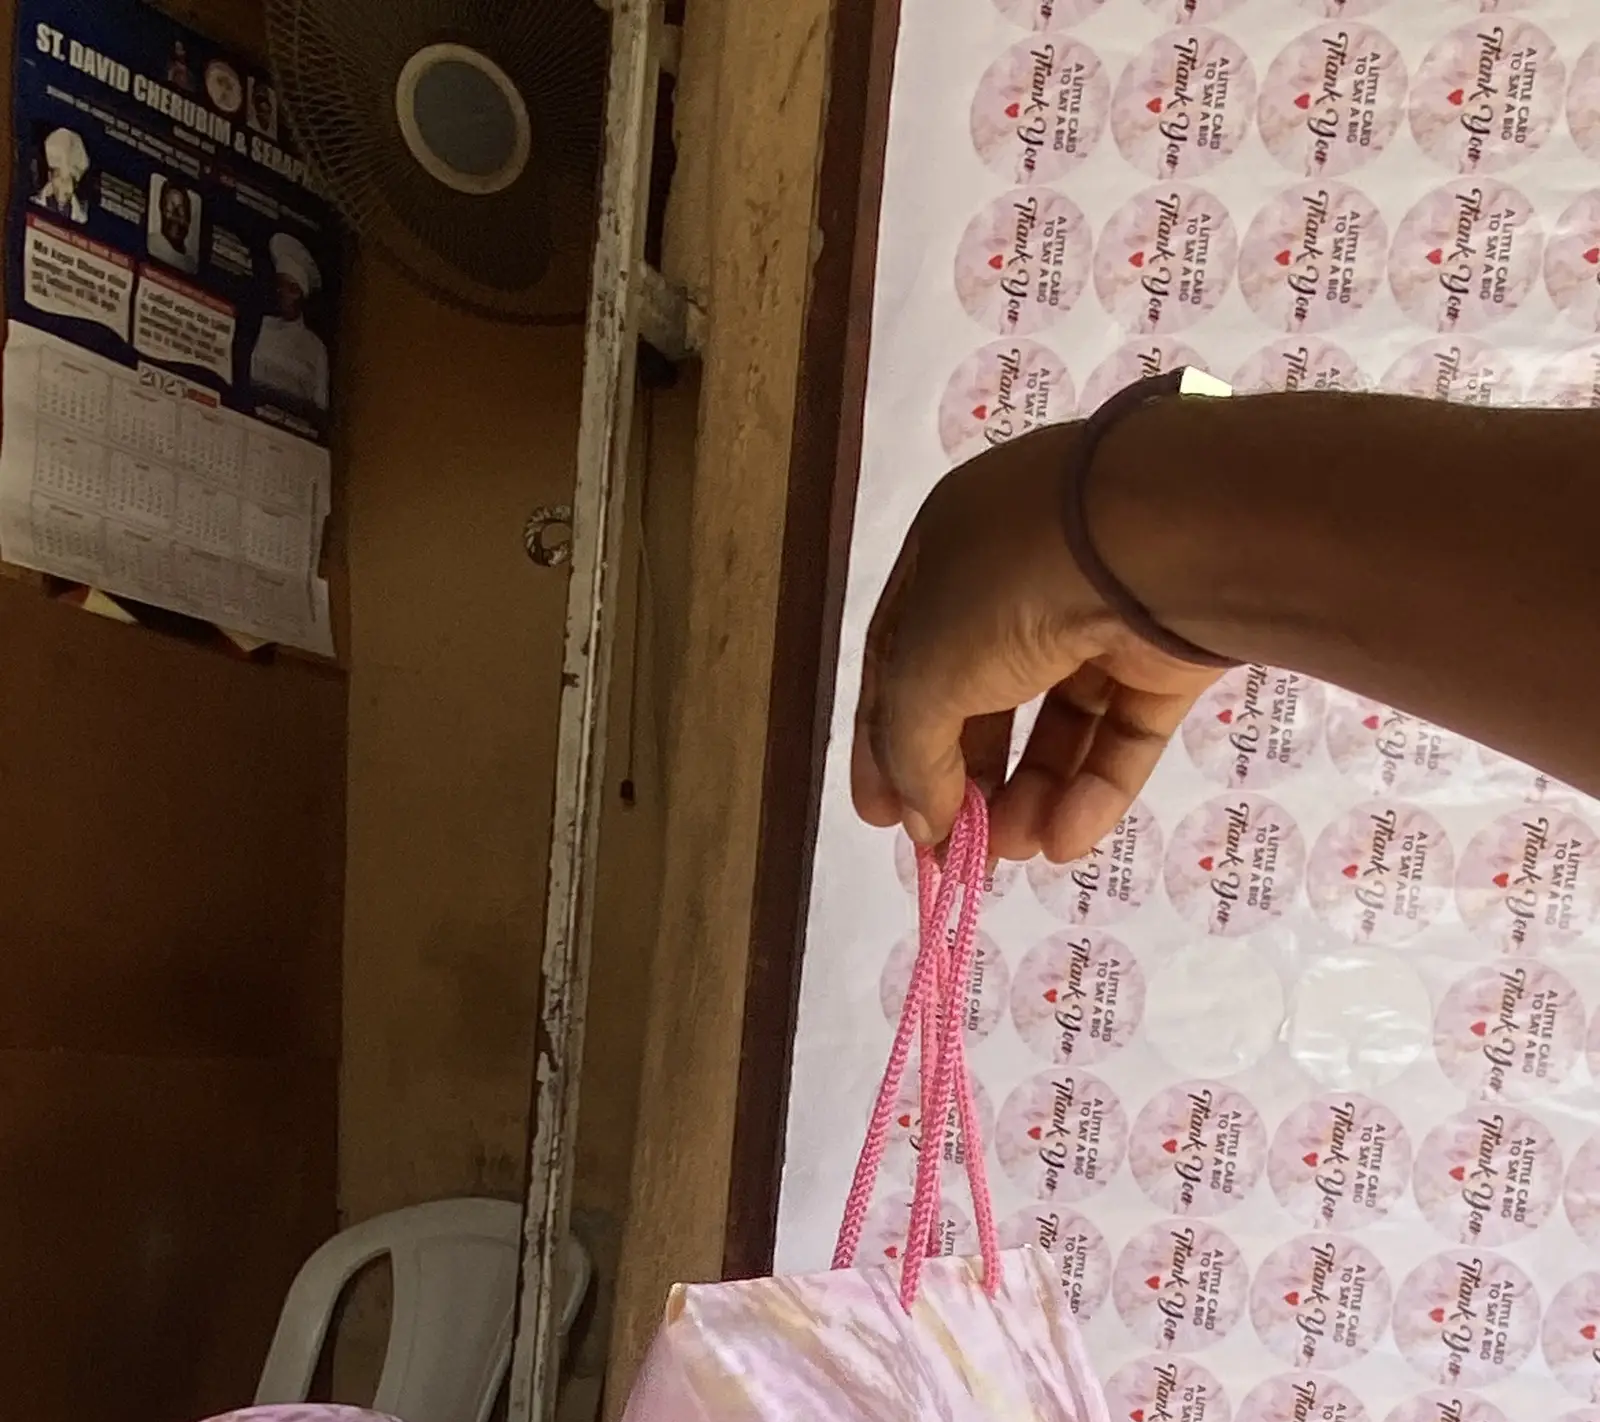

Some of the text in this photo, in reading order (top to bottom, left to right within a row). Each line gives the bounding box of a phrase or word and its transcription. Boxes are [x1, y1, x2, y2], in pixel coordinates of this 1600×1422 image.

[1204, 61, 1217, 81] TO
[1354, 55, 1368, 76] TO
[1510, 51, 1524, 72] TO
[35, 23, 66, 62] ST.
[69, 41, 130, 93] DAVID
[133, 75, 231, 146] CHERUBIM
[233, 131, 247, 156] &
[1202, 84, 1214, 108] SAY
[1351, 79, 1365, 104] SAY
[1359, 51, 1381, 147] A LITTLE CARD
[1460, 26, 1504, 166] Thank You
[1506, 75, 1520, 100] SAY
[1514, 46, 1538, 144] A LITTLE CARD
[1159, 37, 1199, 171] Thank You
[1209, 56, 1230, 150] A LITTLE CARD
[1307, 32, 1348, 168] Thank You
[1504, 104, 1516, 114] A
[1200, 112, 1210, 122] A
[1349, 108, 1360, 118] A
[1043, 219, 1055, 239] TO
[1334, 214, 1347, 234] TO
[1000, 196, 1037, 326] Thank You
[1041, 241, 1053, 265] SAY
[1048, 215, 1068, 306] A LITTLE CARD
[1287, 190, 1329, 325] Thank You
[1331, 237, 1345, 262] SAY
[1339, 210, 1361, 304] A LITTLE CARD
[1039, 269, 1049, 279] A
[1329, 265, 1340, 275] A
[1255, 825, 1267, 845] TO
[1210, 802, 1249, 927] Thank You
[1252, 847, 1265, 870] SAY
[1259, 823, 1280, 911] A LITTLE CARD
[1250, 873, 1260, 883] A
[1096, 960, 1108, 979] TO
[1054, 937, 1091, 1057] Thank You
[1094, 981, 1106, 1004] SAY
[1101, 958, 1121, 1043] A LITTLE CARD
[1092, 1006, 1102, 1015] A
[1217, 1112, 1230, 1131] TO
[1174, 1089, 1212, 1208] Thank You
[1215, 1132, 1227, 1155] SAY
[1222, 1110, 1242, 1194] A LITTLE CARD
[1509, 1138, 1523, 1158] TO
[1213, 1157, 1223, 1167] A
[1506, 1159, 1520, 1183] SAY
[1461, 1114, 1504, 1237] Thank You
[1513, 1136, 1536, 1223] A LITTLE CARD
[1504, 1185, 1515, 1195] A
[1200, 1250, 1212, 1269] TO
[1157, 1227, 1194, 1344] Thank You
[1197, 1270, 1209, 1293] SAY
[1204, 1248, 1224, 1331] A LITTLE CARD
[1195, 1295, 1205, 1304] A
